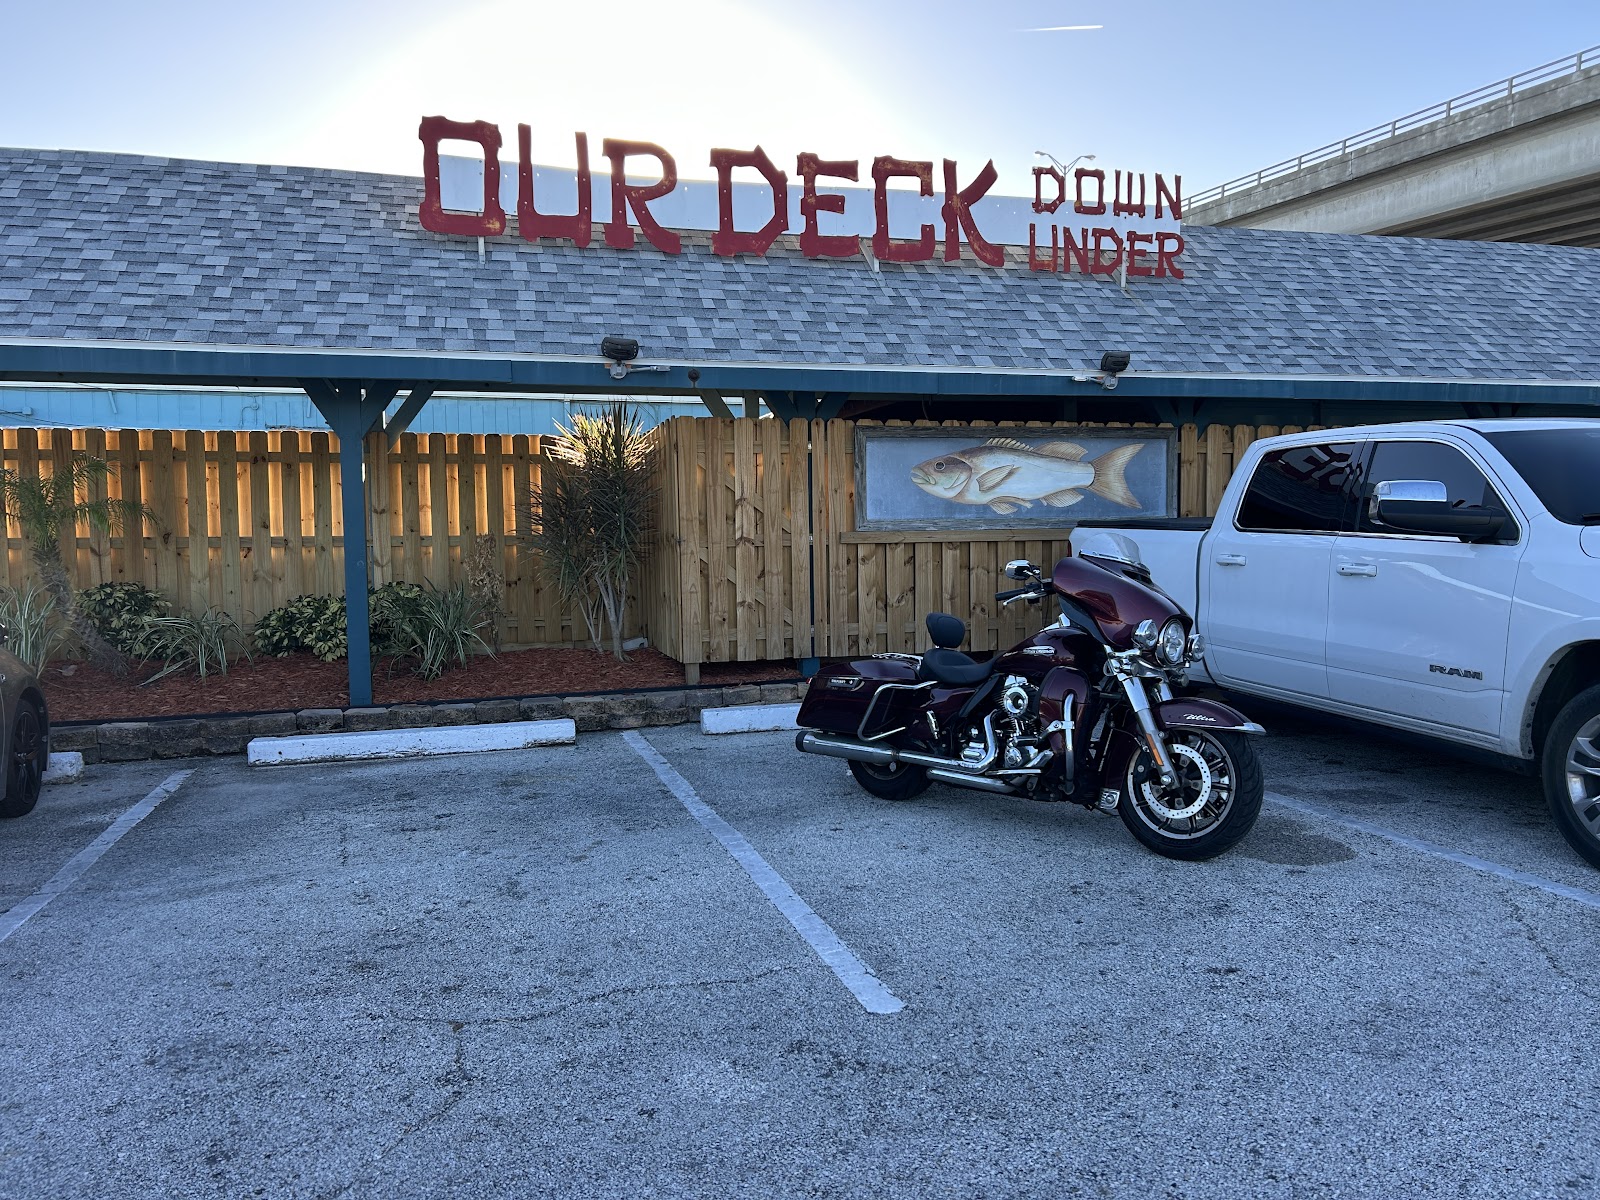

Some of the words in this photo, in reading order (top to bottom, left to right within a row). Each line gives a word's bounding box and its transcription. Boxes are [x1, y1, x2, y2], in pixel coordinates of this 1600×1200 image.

[418, 115, 682, 255] OUR
[709, 145, 1004, 267] DECK
[1032, 165, 1182, 220] DOWN
[1029, 223, 1184, 279] UNDER
[1429, 664, 1483, 681] RAM
